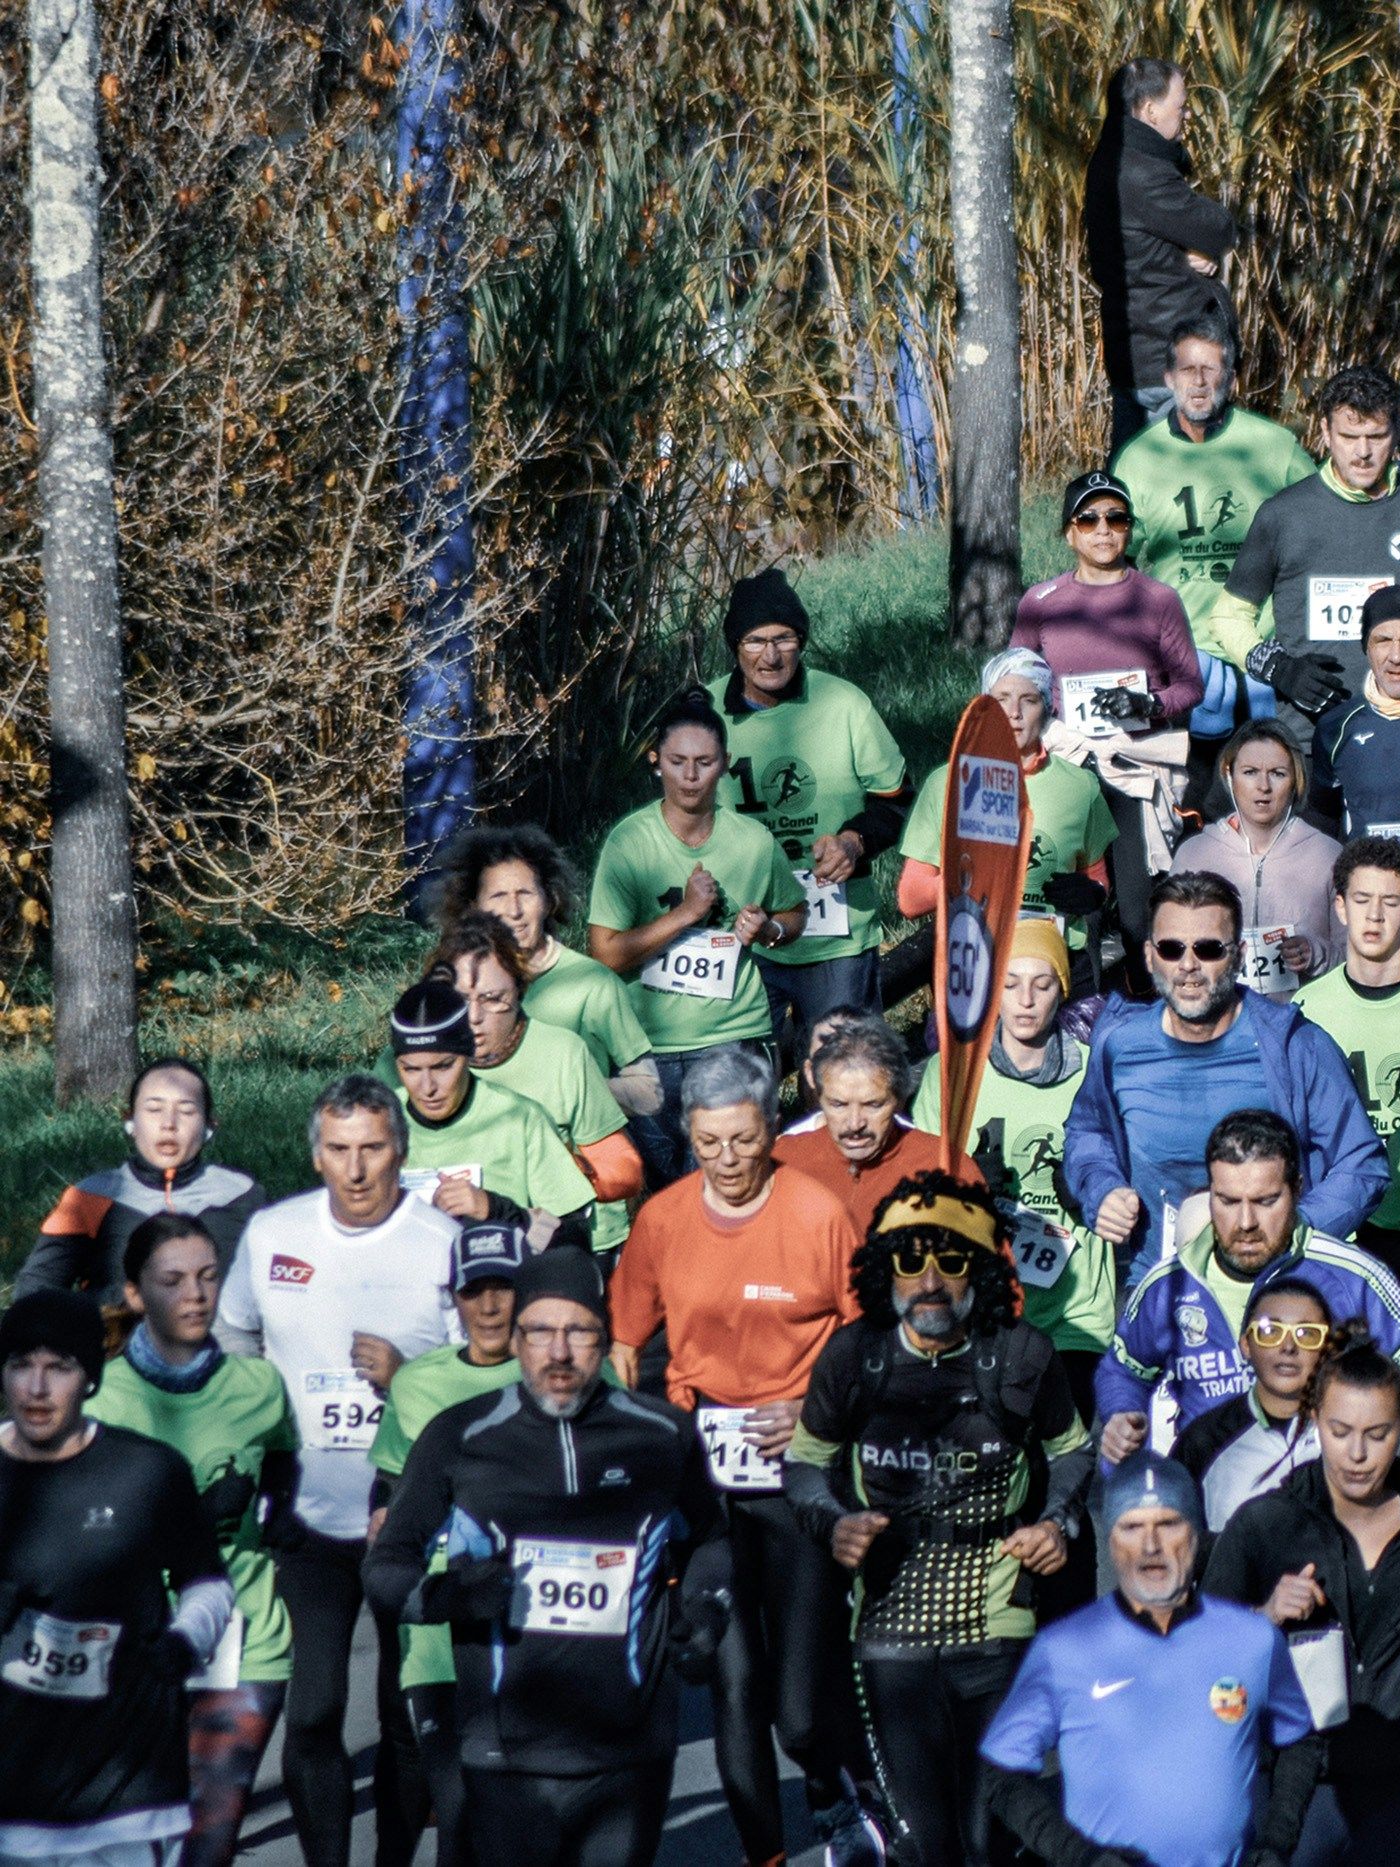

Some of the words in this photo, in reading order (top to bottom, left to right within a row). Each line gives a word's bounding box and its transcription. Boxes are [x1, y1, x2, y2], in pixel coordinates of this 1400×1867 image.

[1211, 540, 1243, 552] Cana
[983, 766, 1015, 792] INTER
[981, 789, 1015, 817] SPORT
[778, 813, 819, 829] Canal
[660, 953, 726, 981] 1081
[1021, 1192, 1058, 1206] Cana
[273, 1264, 310, 1279] SNCF
[323, 1403, 386, 1429] 594
[538, 1579, 610, 1612] 960
[23, 1640, 89, 1677] 959
